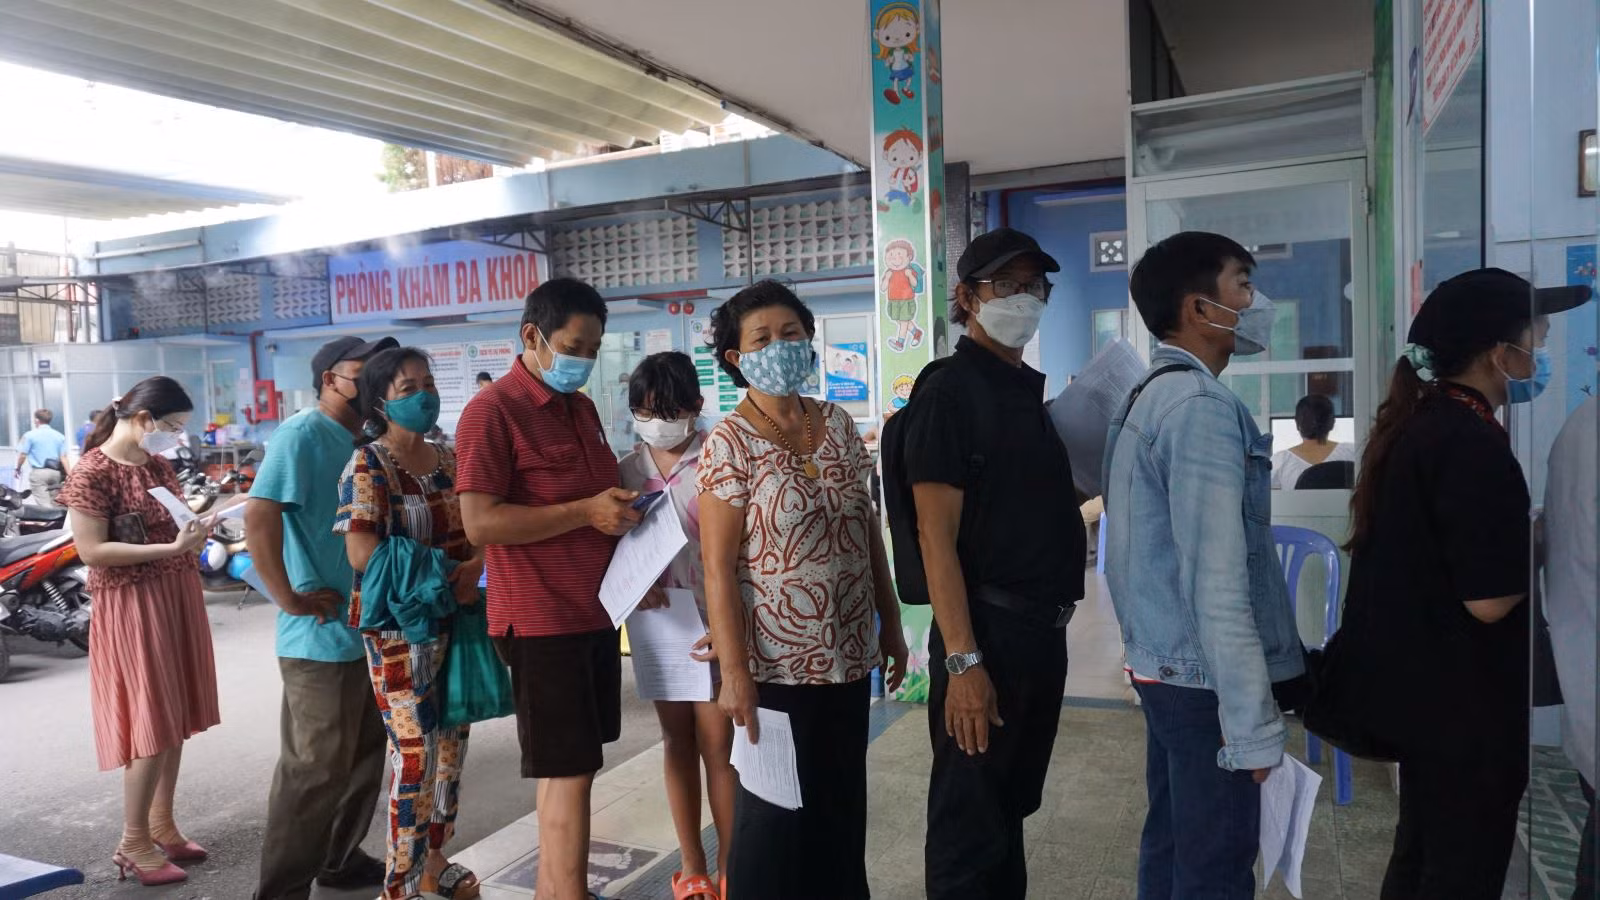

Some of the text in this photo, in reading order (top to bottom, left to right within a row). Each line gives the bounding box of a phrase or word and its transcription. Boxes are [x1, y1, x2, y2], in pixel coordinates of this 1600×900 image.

[335, 252, 540, 314] PHÒNG KHÁM ĐA KHOA
